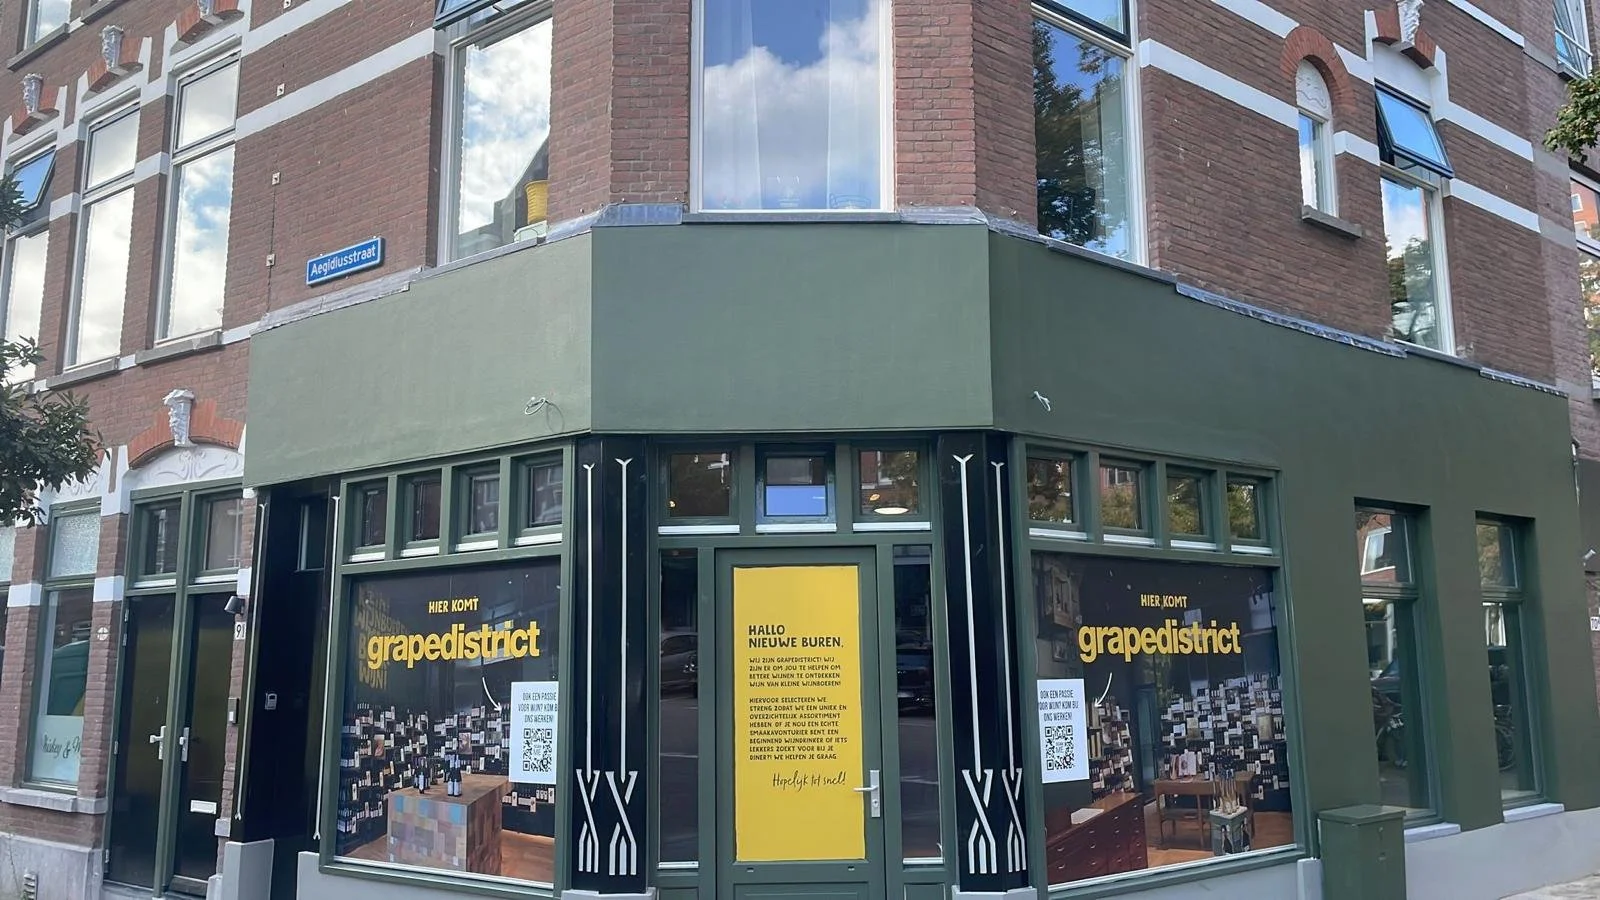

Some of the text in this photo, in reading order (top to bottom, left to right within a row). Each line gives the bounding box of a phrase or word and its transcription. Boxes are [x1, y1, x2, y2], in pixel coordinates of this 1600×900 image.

[311, 244, 376, 277] Aegidiusstraat
[428, 598, 479, 613] HIER KOMT
[1141, 594, 1188, 608] HIER KOMT
[748, 624, 786, 636] HALLO
[367, 620, 541, 670] grapedistrict
[748, 637, 797, 649] NIEUWE
[1078, 619, 1242, 663] grapedistrict
[532, 692, 541, 701] EEN
[1050, 690, 1059, 699] EEN
[810, 773, 821, 787] tot
[823, 771, 846, 786] snel!
